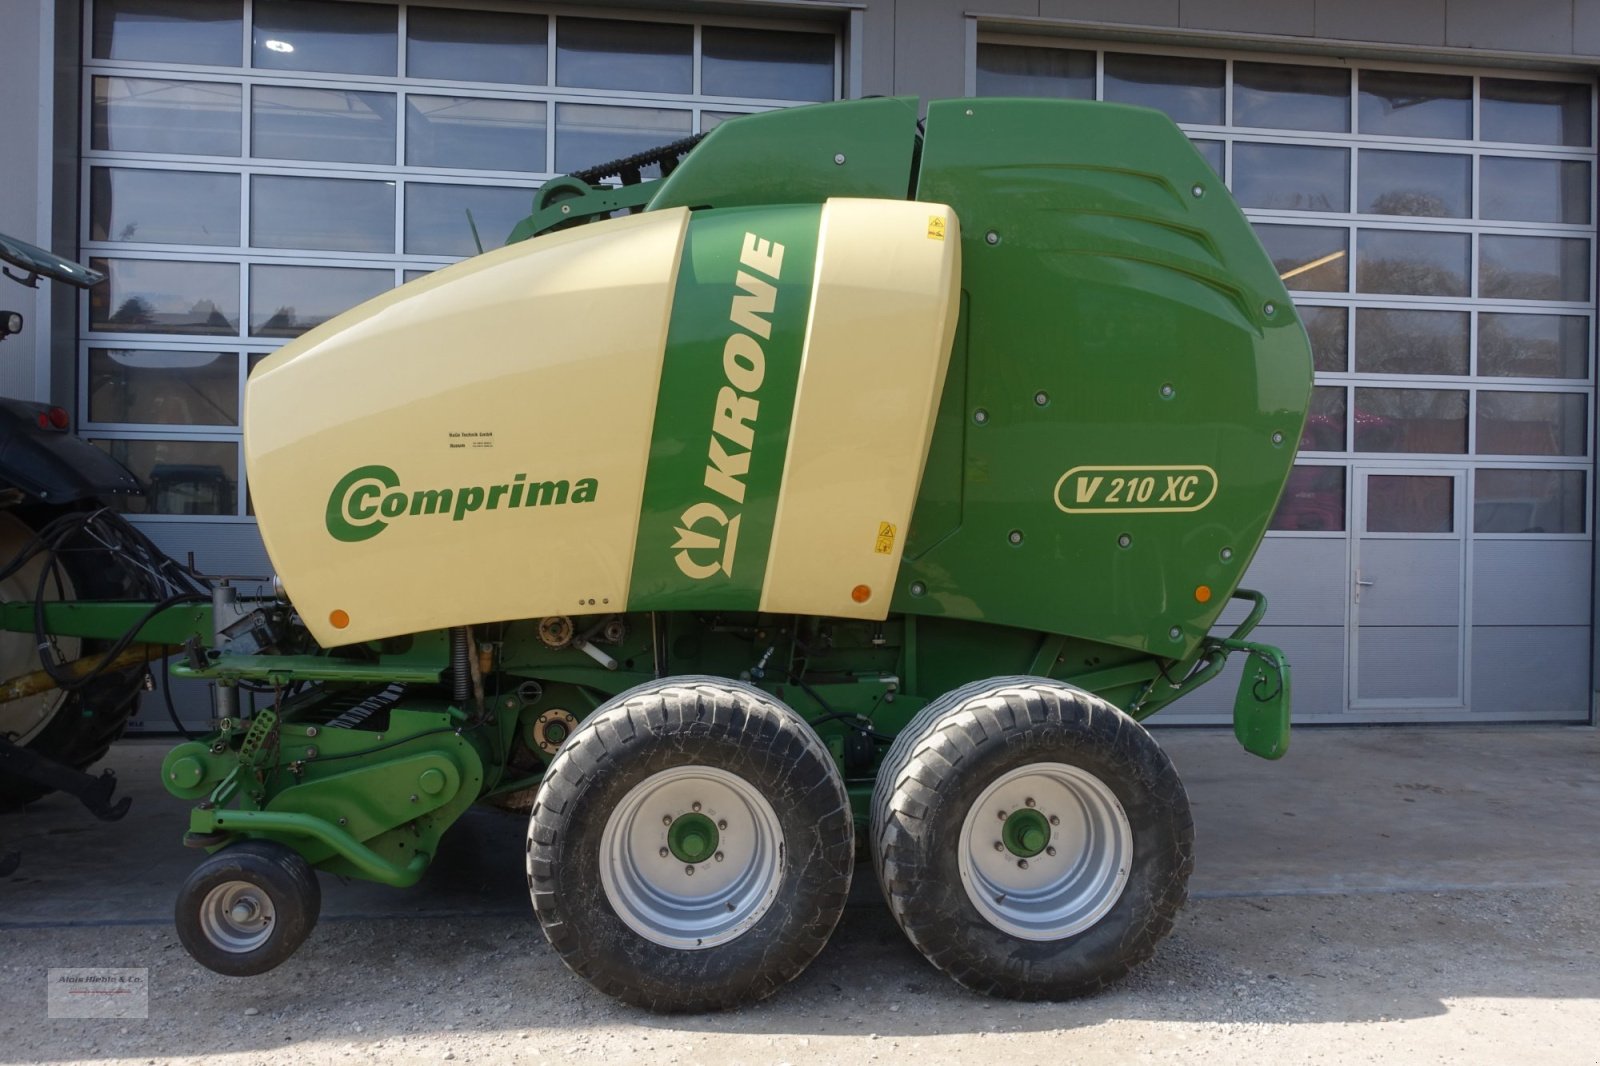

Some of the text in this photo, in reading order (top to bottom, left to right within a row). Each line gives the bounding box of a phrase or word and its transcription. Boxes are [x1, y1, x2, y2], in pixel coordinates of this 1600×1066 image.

[703, 231, 785, 505] KRONE
[326, 465, 599, 542] Comprima
[1076, 475, 1199, 503] V 210 XC
